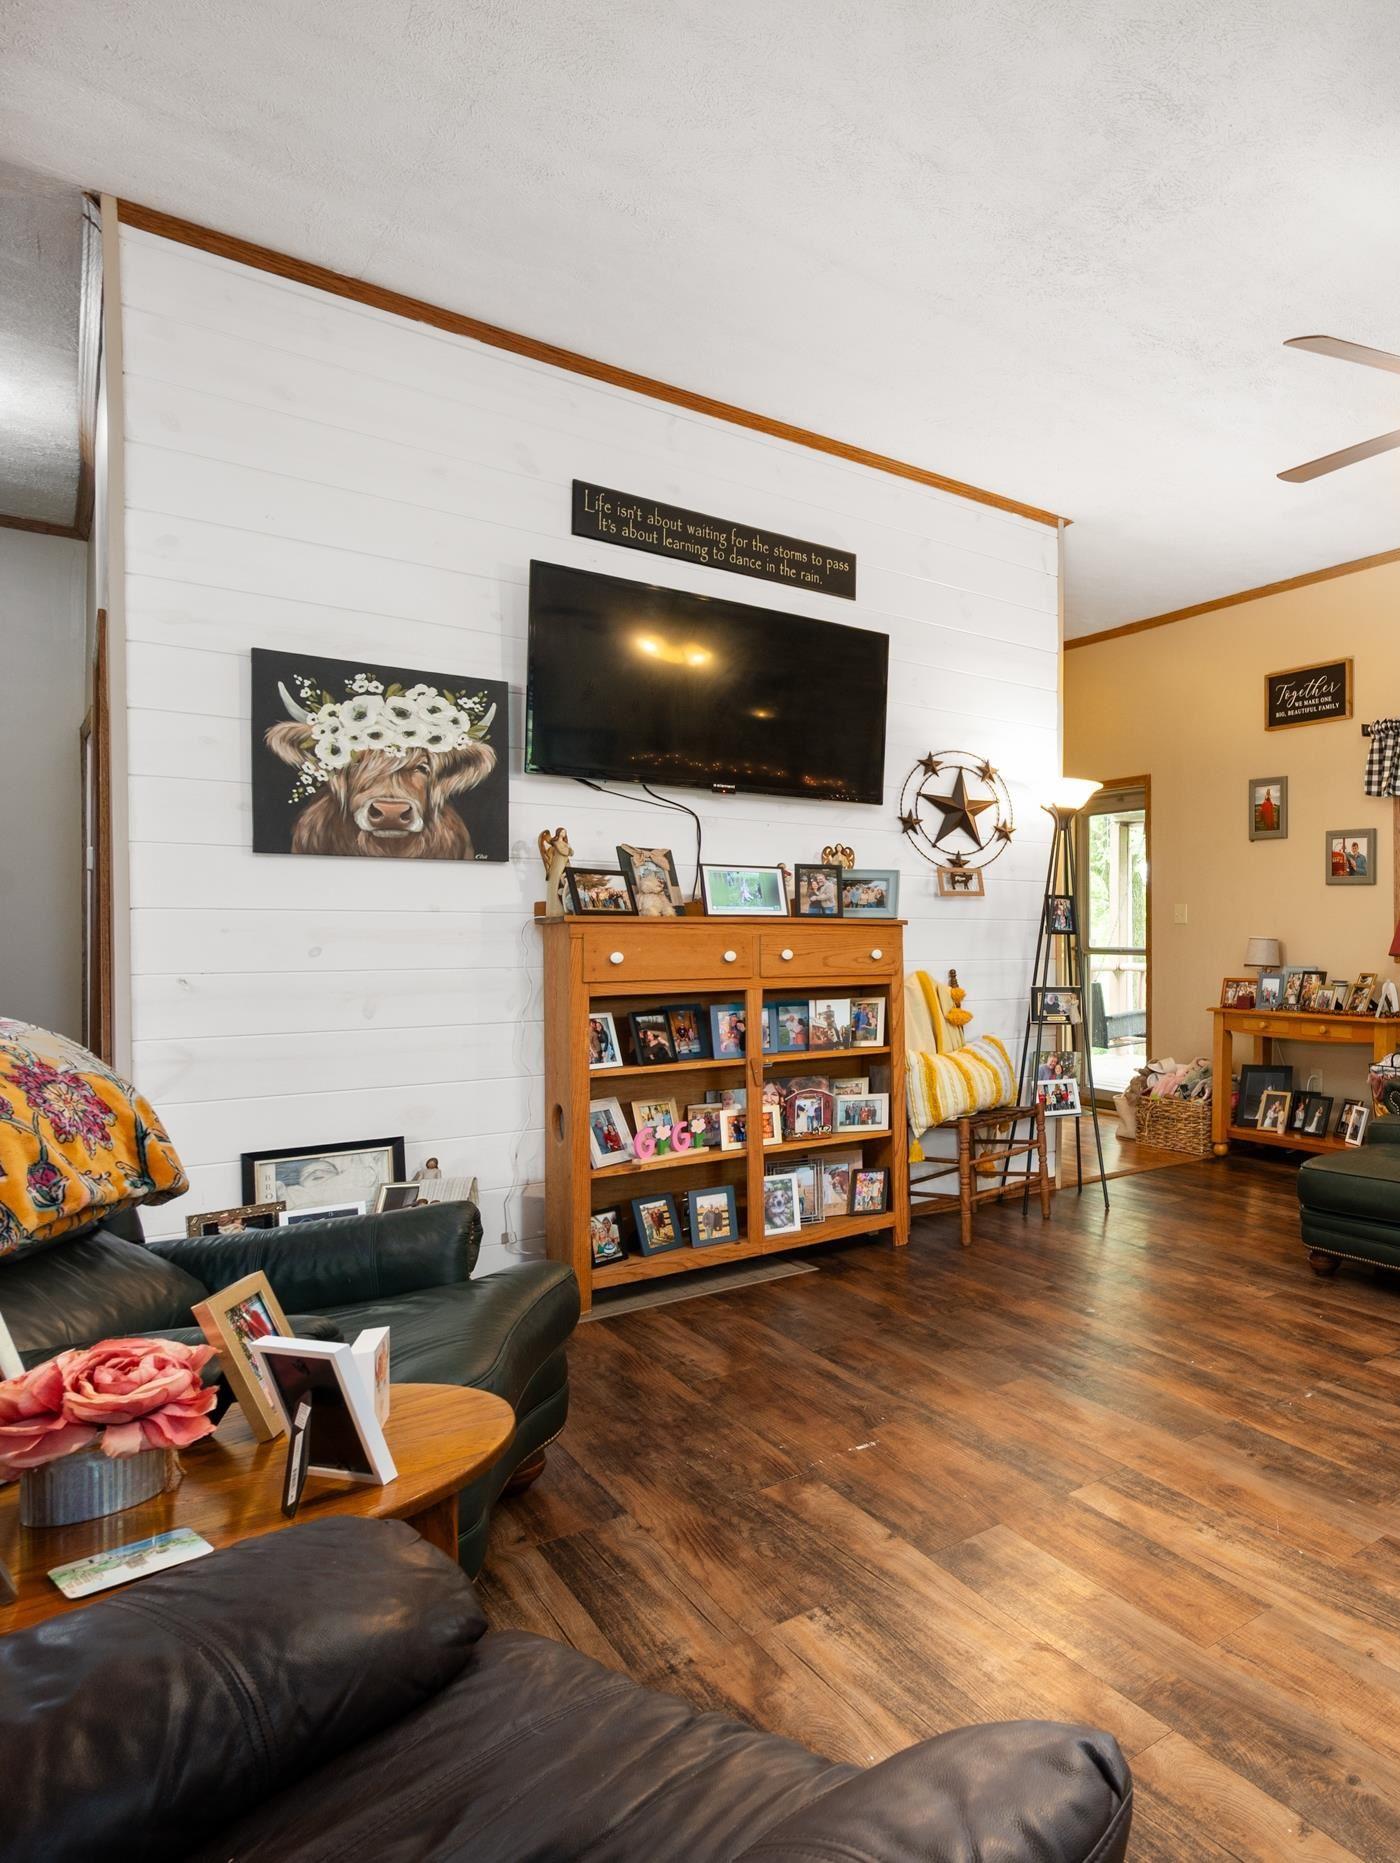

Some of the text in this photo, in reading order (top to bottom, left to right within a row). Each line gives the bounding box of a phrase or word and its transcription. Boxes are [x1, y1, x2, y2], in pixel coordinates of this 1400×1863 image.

[584, 489, 850, 575] Life isn't about waiting for the storms to pass
[598, 511, 823, 585] It's about learning to dance in the rain.
[1275, 675, 1341, 708] Together
[1303, 698, 1319, 706] MAKE
[1320, 695, 1332, 703] ONE
[1287, 707, 1317, 716] BEAUTIFUL
[1318, 702, 1340, 711] FAMILY
